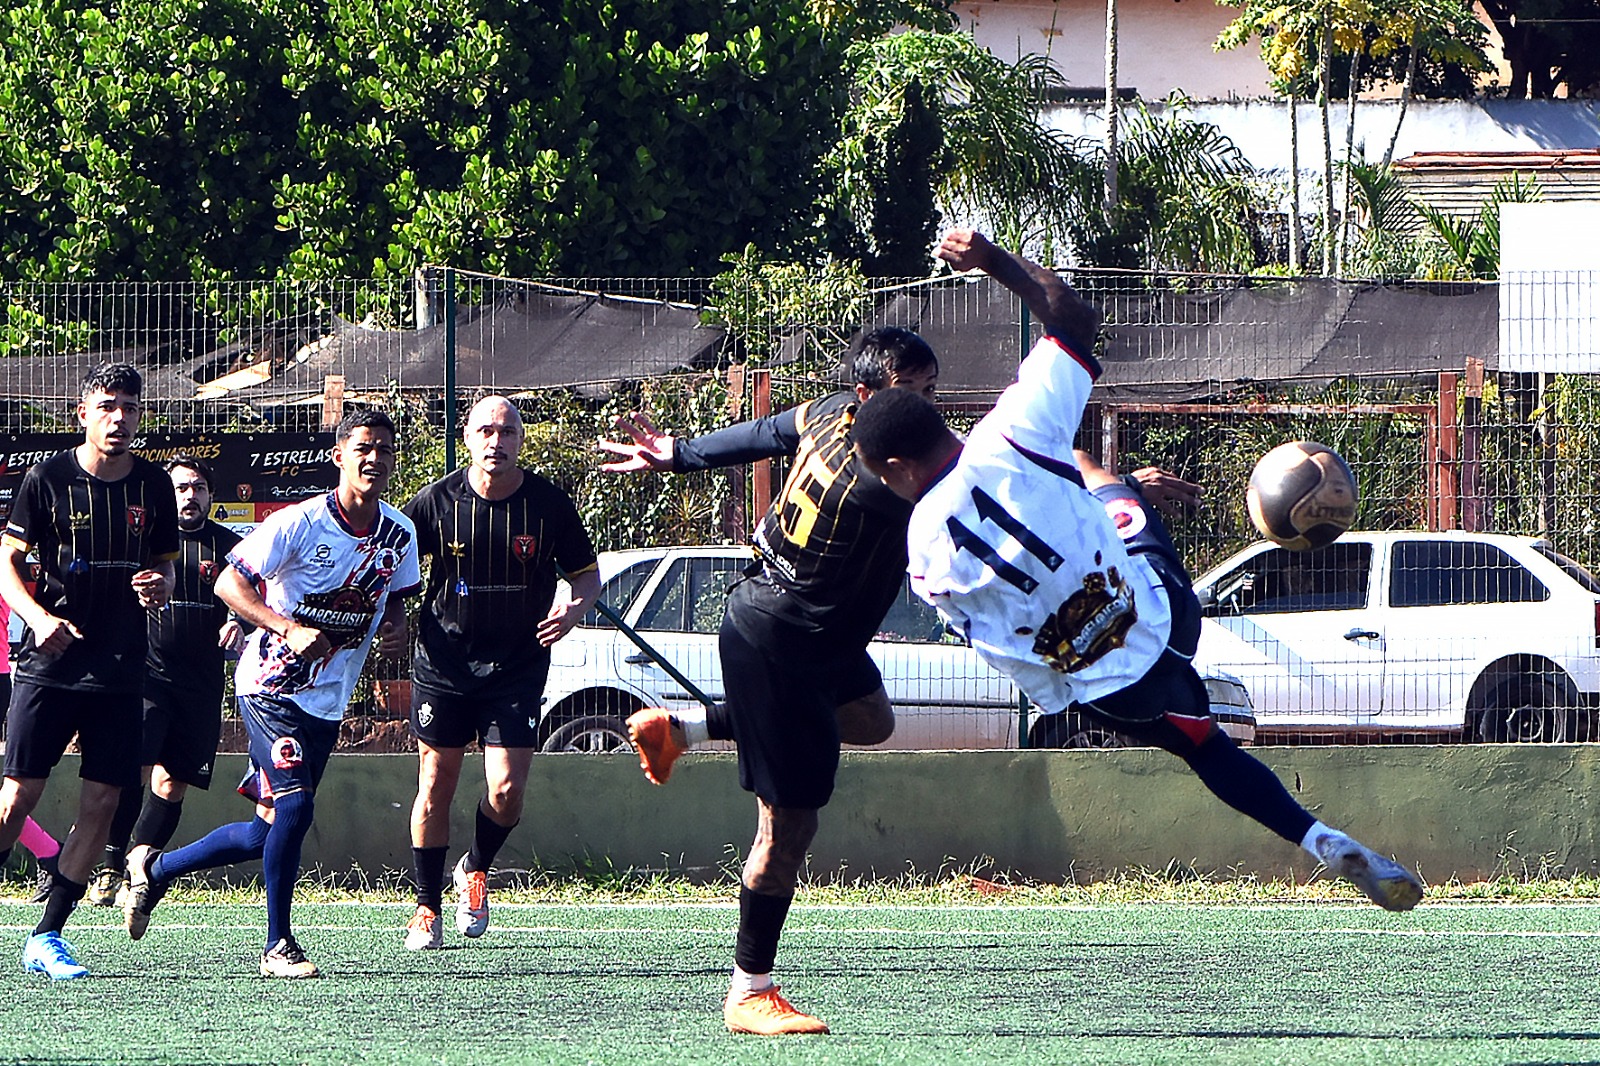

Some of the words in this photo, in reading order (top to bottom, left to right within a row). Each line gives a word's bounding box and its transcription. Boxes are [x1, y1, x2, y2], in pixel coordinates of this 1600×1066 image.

[250, 453, 261, 467] 7
[263, 449, 333, 467] ESTRELAS
[280, 466, 300, 477] FC
[946, 485, 1065, 596] 11
